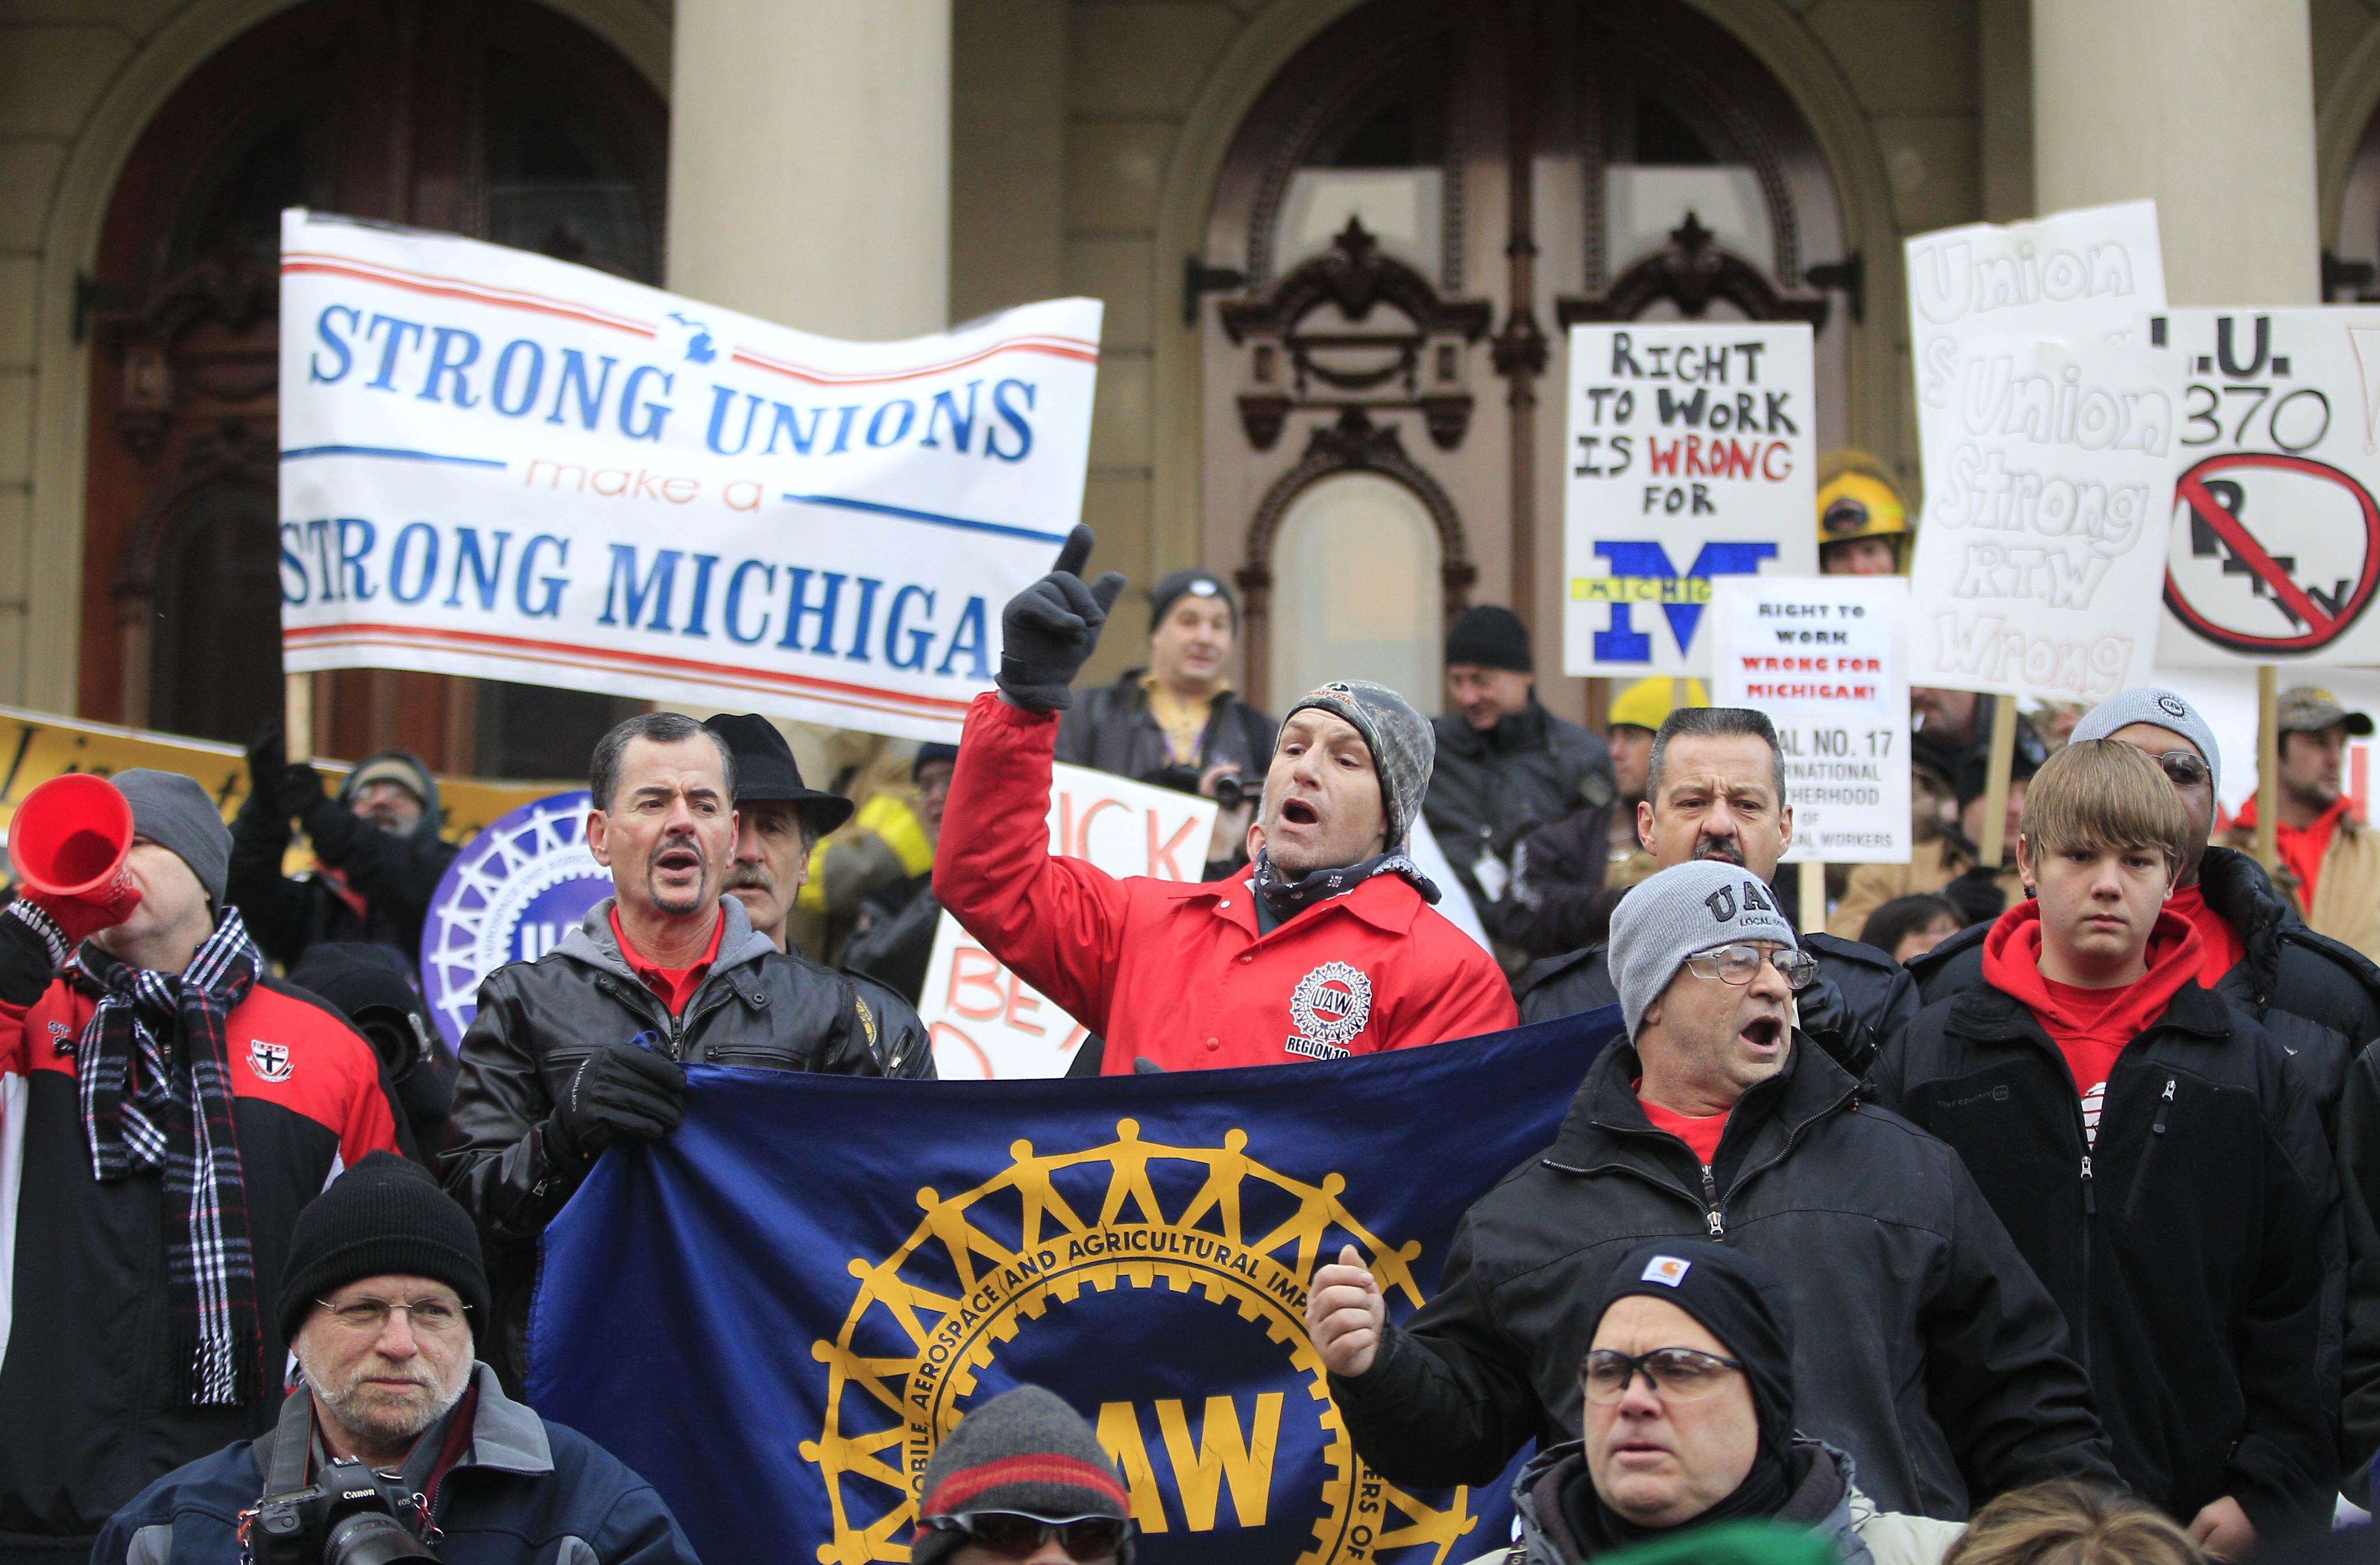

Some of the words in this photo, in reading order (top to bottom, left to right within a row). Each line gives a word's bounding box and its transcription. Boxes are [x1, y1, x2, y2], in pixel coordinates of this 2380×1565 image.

[1912, 240, 2136, 325] Union
[1612, 333, 1766, 383] RIGHT
[308, 304, 675, 444] STRONG
[705, 377, 1038, 465] UNIONS
[1588, 388, 1635, 426] TO
[1658, 388, 1799, 435] WORK
[1965, 355, 2173, 459] Union
[2181, 385, 2330, 457] 370
[1575, 436, 1632, 478] IS
[1649, 435, 1793, 481] WRONG
[525, 456, 701, 505] make
[724, 476, 766, 514] a
[1643, 483, 1717, 515] FOR
[1932, 442, 2150, 559] Strong
[281, 516, 571, 620] STRONG
[597, 542, 997, 681] MICHIGA
[1589, 579, 1712, 601] MICHIG
[1758, 604, 1830, 618] RIGHT
[1838, 606, 1865, 617] TO
[1775, 630, 1849, 644] WORK
[1740, 657, 1830, 671] WRONG
[1836, 658, 1882, 673] FOR
[1932, 611, 2135, 706] Wrong
[1746, 684, 1876, 700] MICHIGAN!
[1777, 729, 1805, 756] AL
[1813, 729, 1856, 757] NO.
[1866, 730, 1894, 757] 17
[1784, 763, 1882, 781] RNATIONAL
[1790, 788, 1880, 805] HERHOOD
[1060, 791, 1202, 883] ICK
[1705, 881, 1784, 923] UA
[1739, 917, 1772, 927] LOCAL
[1312, 987, 1354, 1014] UAW
[1287, 1037, 1332, 1060] REGION
[915, 1285, 1000, 1407] AEROSPACE
[1007, 1250, 1057, 1290] AND
[1069, 1230, 1261, 1280] AGRICULTURAL
[1266, 1271, 1309, 1319] IMP
[1096, 1392, 1285, 1534] AW
[342, 1488, 375, 1500] Canon
[398, 1497, 411, 1506] EOS
[1346, 1525, 1373, 1561] OF
